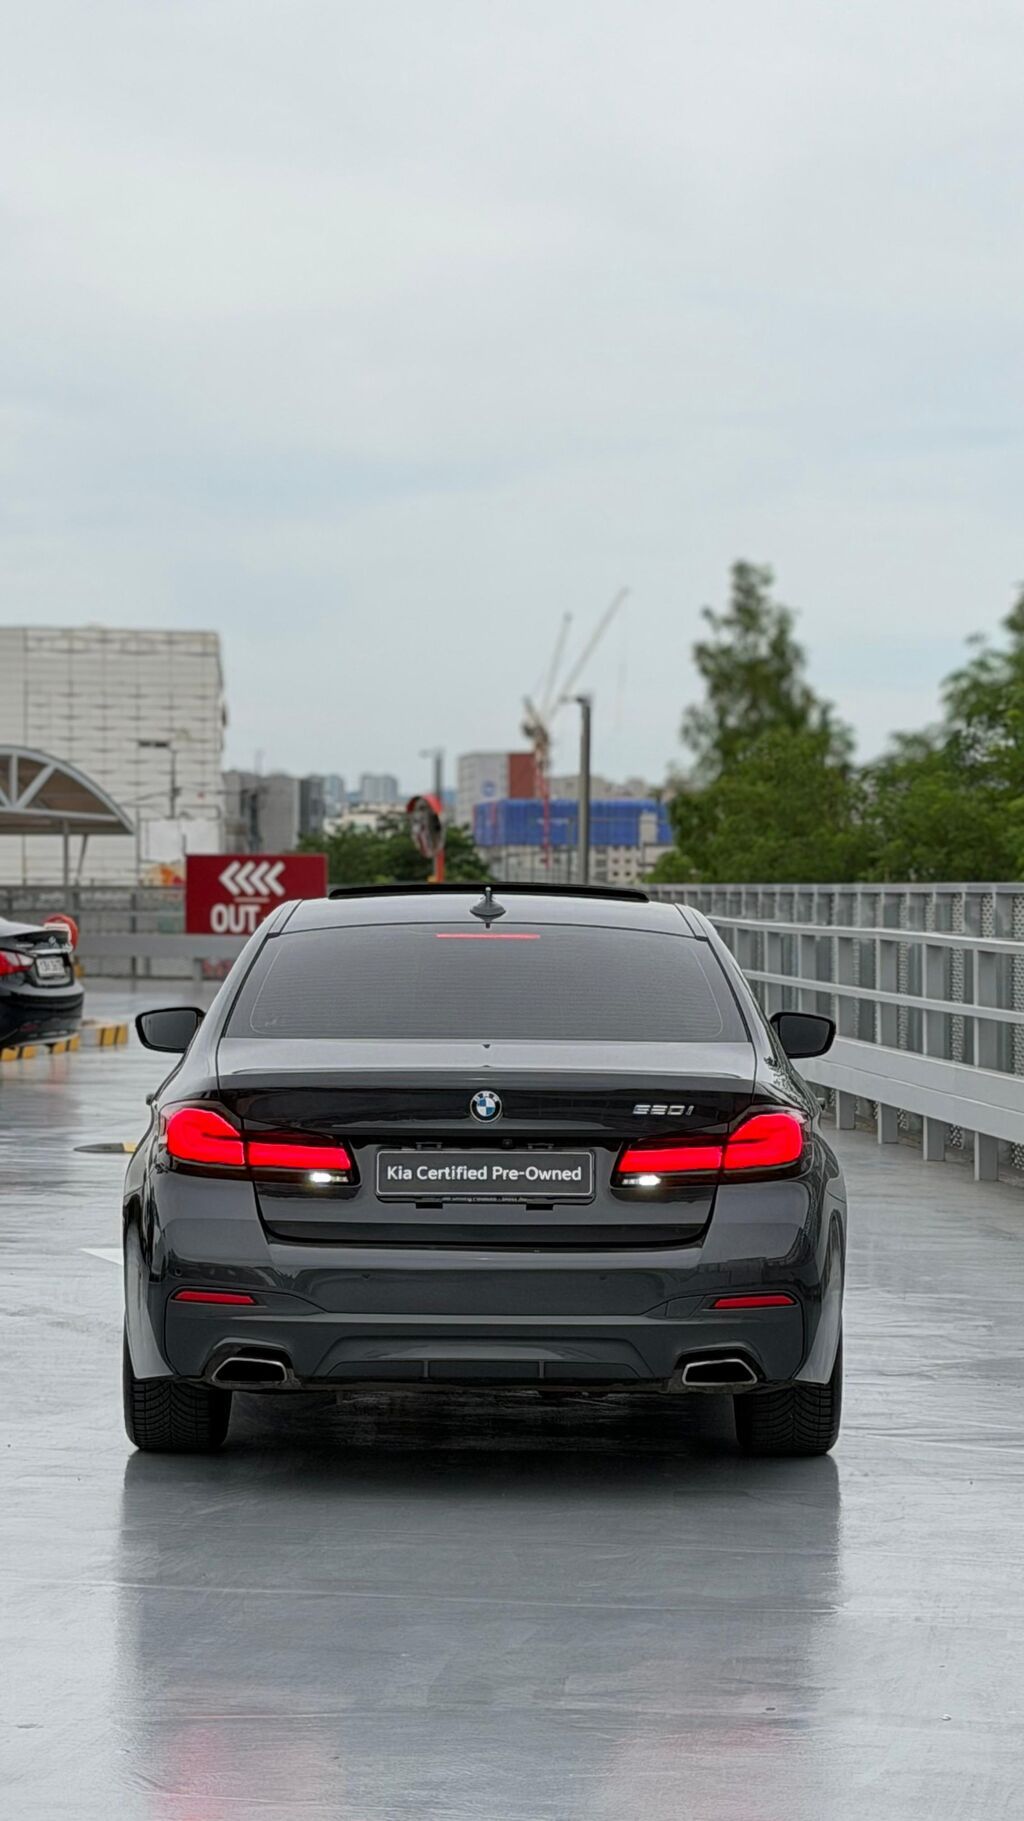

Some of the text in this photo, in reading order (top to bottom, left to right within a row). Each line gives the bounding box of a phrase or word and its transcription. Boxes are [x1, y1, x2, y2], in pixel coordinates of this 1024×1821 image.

[210, 903, 261, 934] OUT
[387, 1166, 582, 1181] Kia Certified Pre-Owned
